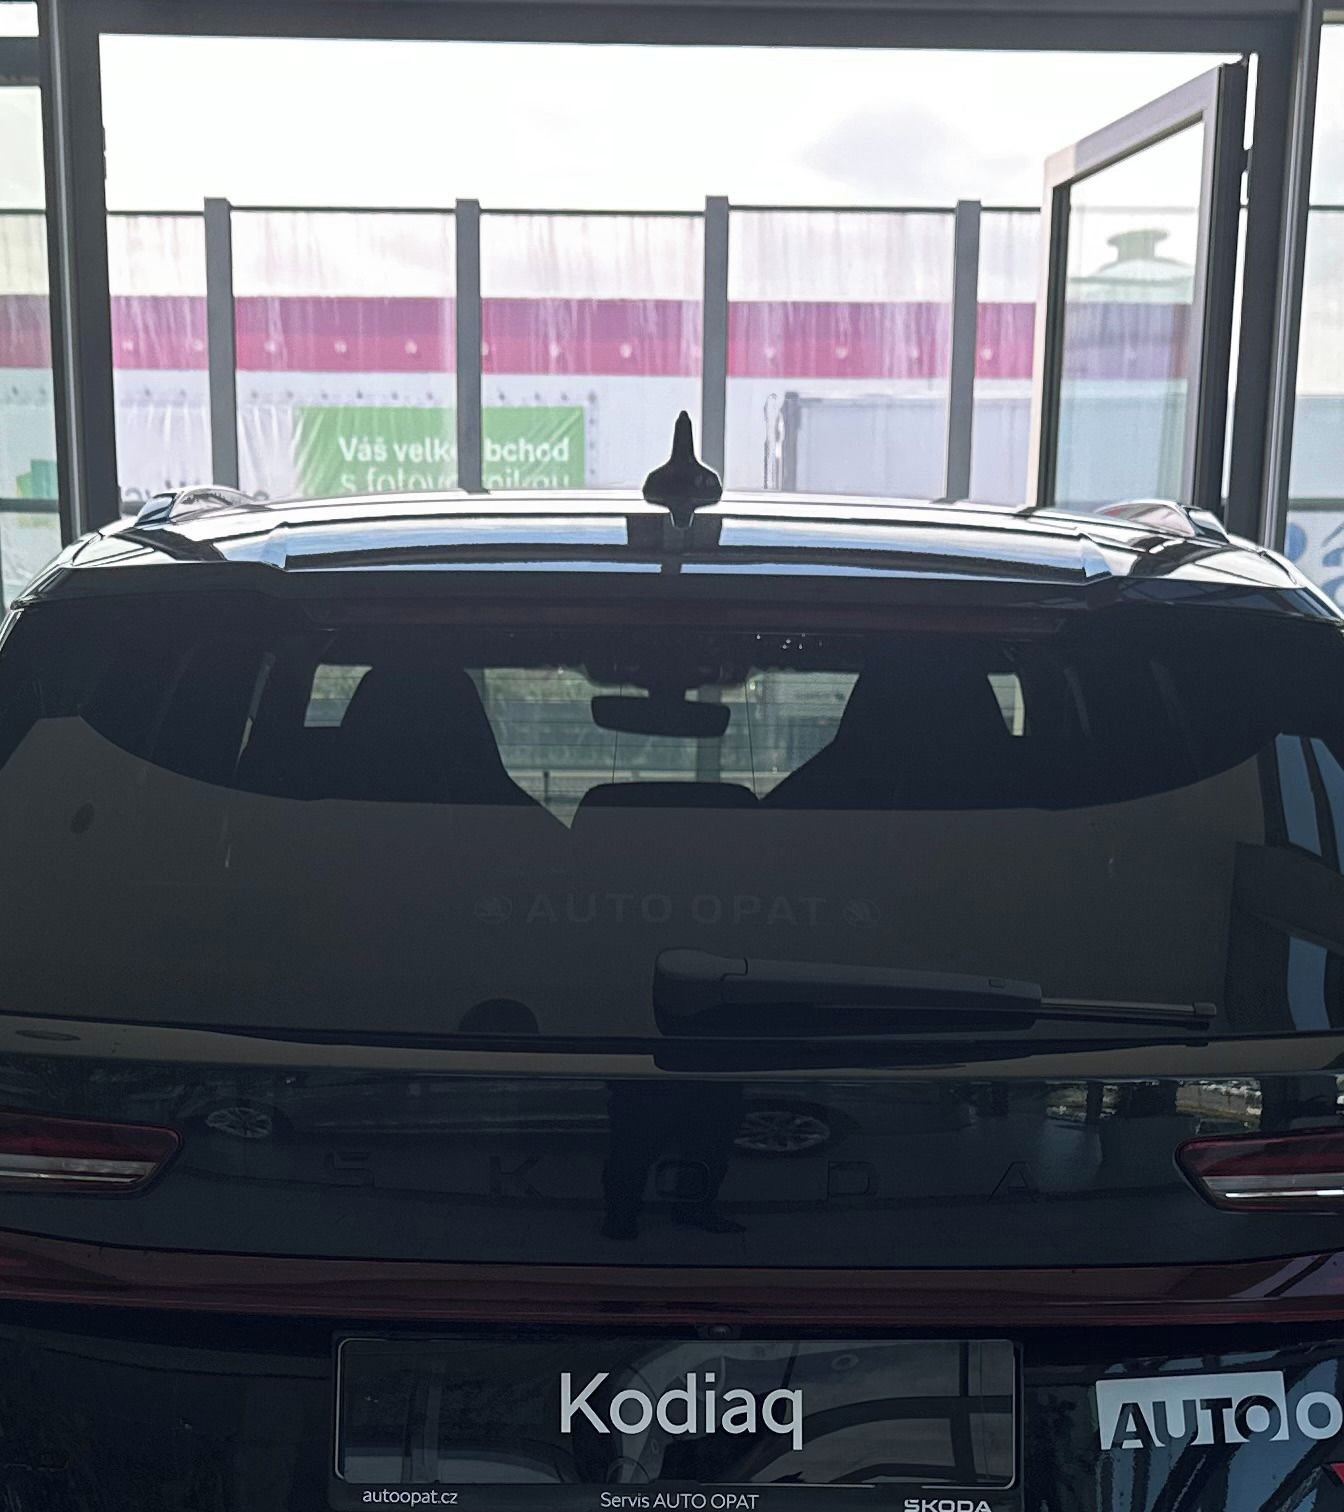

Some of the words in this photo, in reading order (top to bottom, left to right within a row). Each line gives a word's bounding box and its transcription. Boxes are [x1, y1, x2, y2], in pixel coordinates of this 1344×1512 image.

[393, 436, 570, 463] velkbchod
[526, 893, 673, 925] AUTO
[692, 895, 828, 927] OPAT
[560, 1372, 803, 1451] Kodiaq
[1110, 1393, 1284, 1450] AUTO
[362, 1488, 458, 1508] autoopat.cz
[600, 1491, 650, 1509] Servis
[652, 1493, 706, 1510] AUTO
[710, 1494, 760, 1510] OPAT
